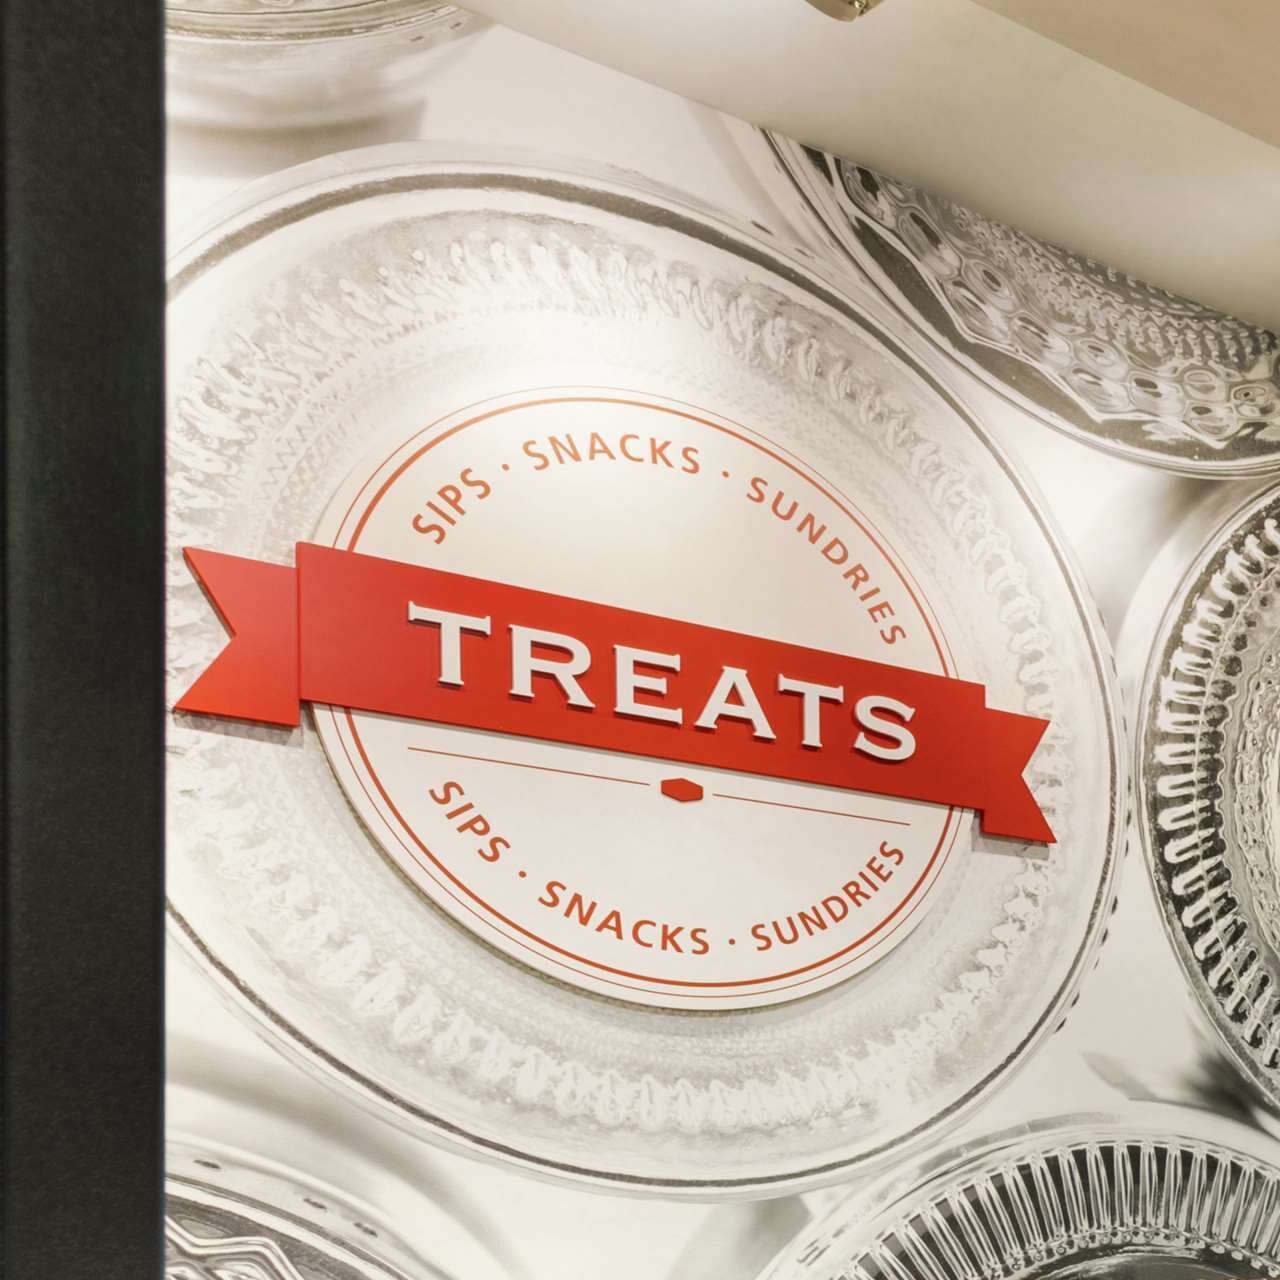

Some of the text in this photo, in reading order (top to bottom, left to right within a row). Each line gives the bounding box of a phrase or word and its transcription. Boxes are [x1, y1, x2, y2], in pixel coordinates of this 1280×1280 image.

[412, 432, 907, 645] SIPS SNACKS SUNDRIES
[407, 600, 917, 762] TREATS
[428, 779, 906, 956] SIPS SNACKS SUNDRIES
